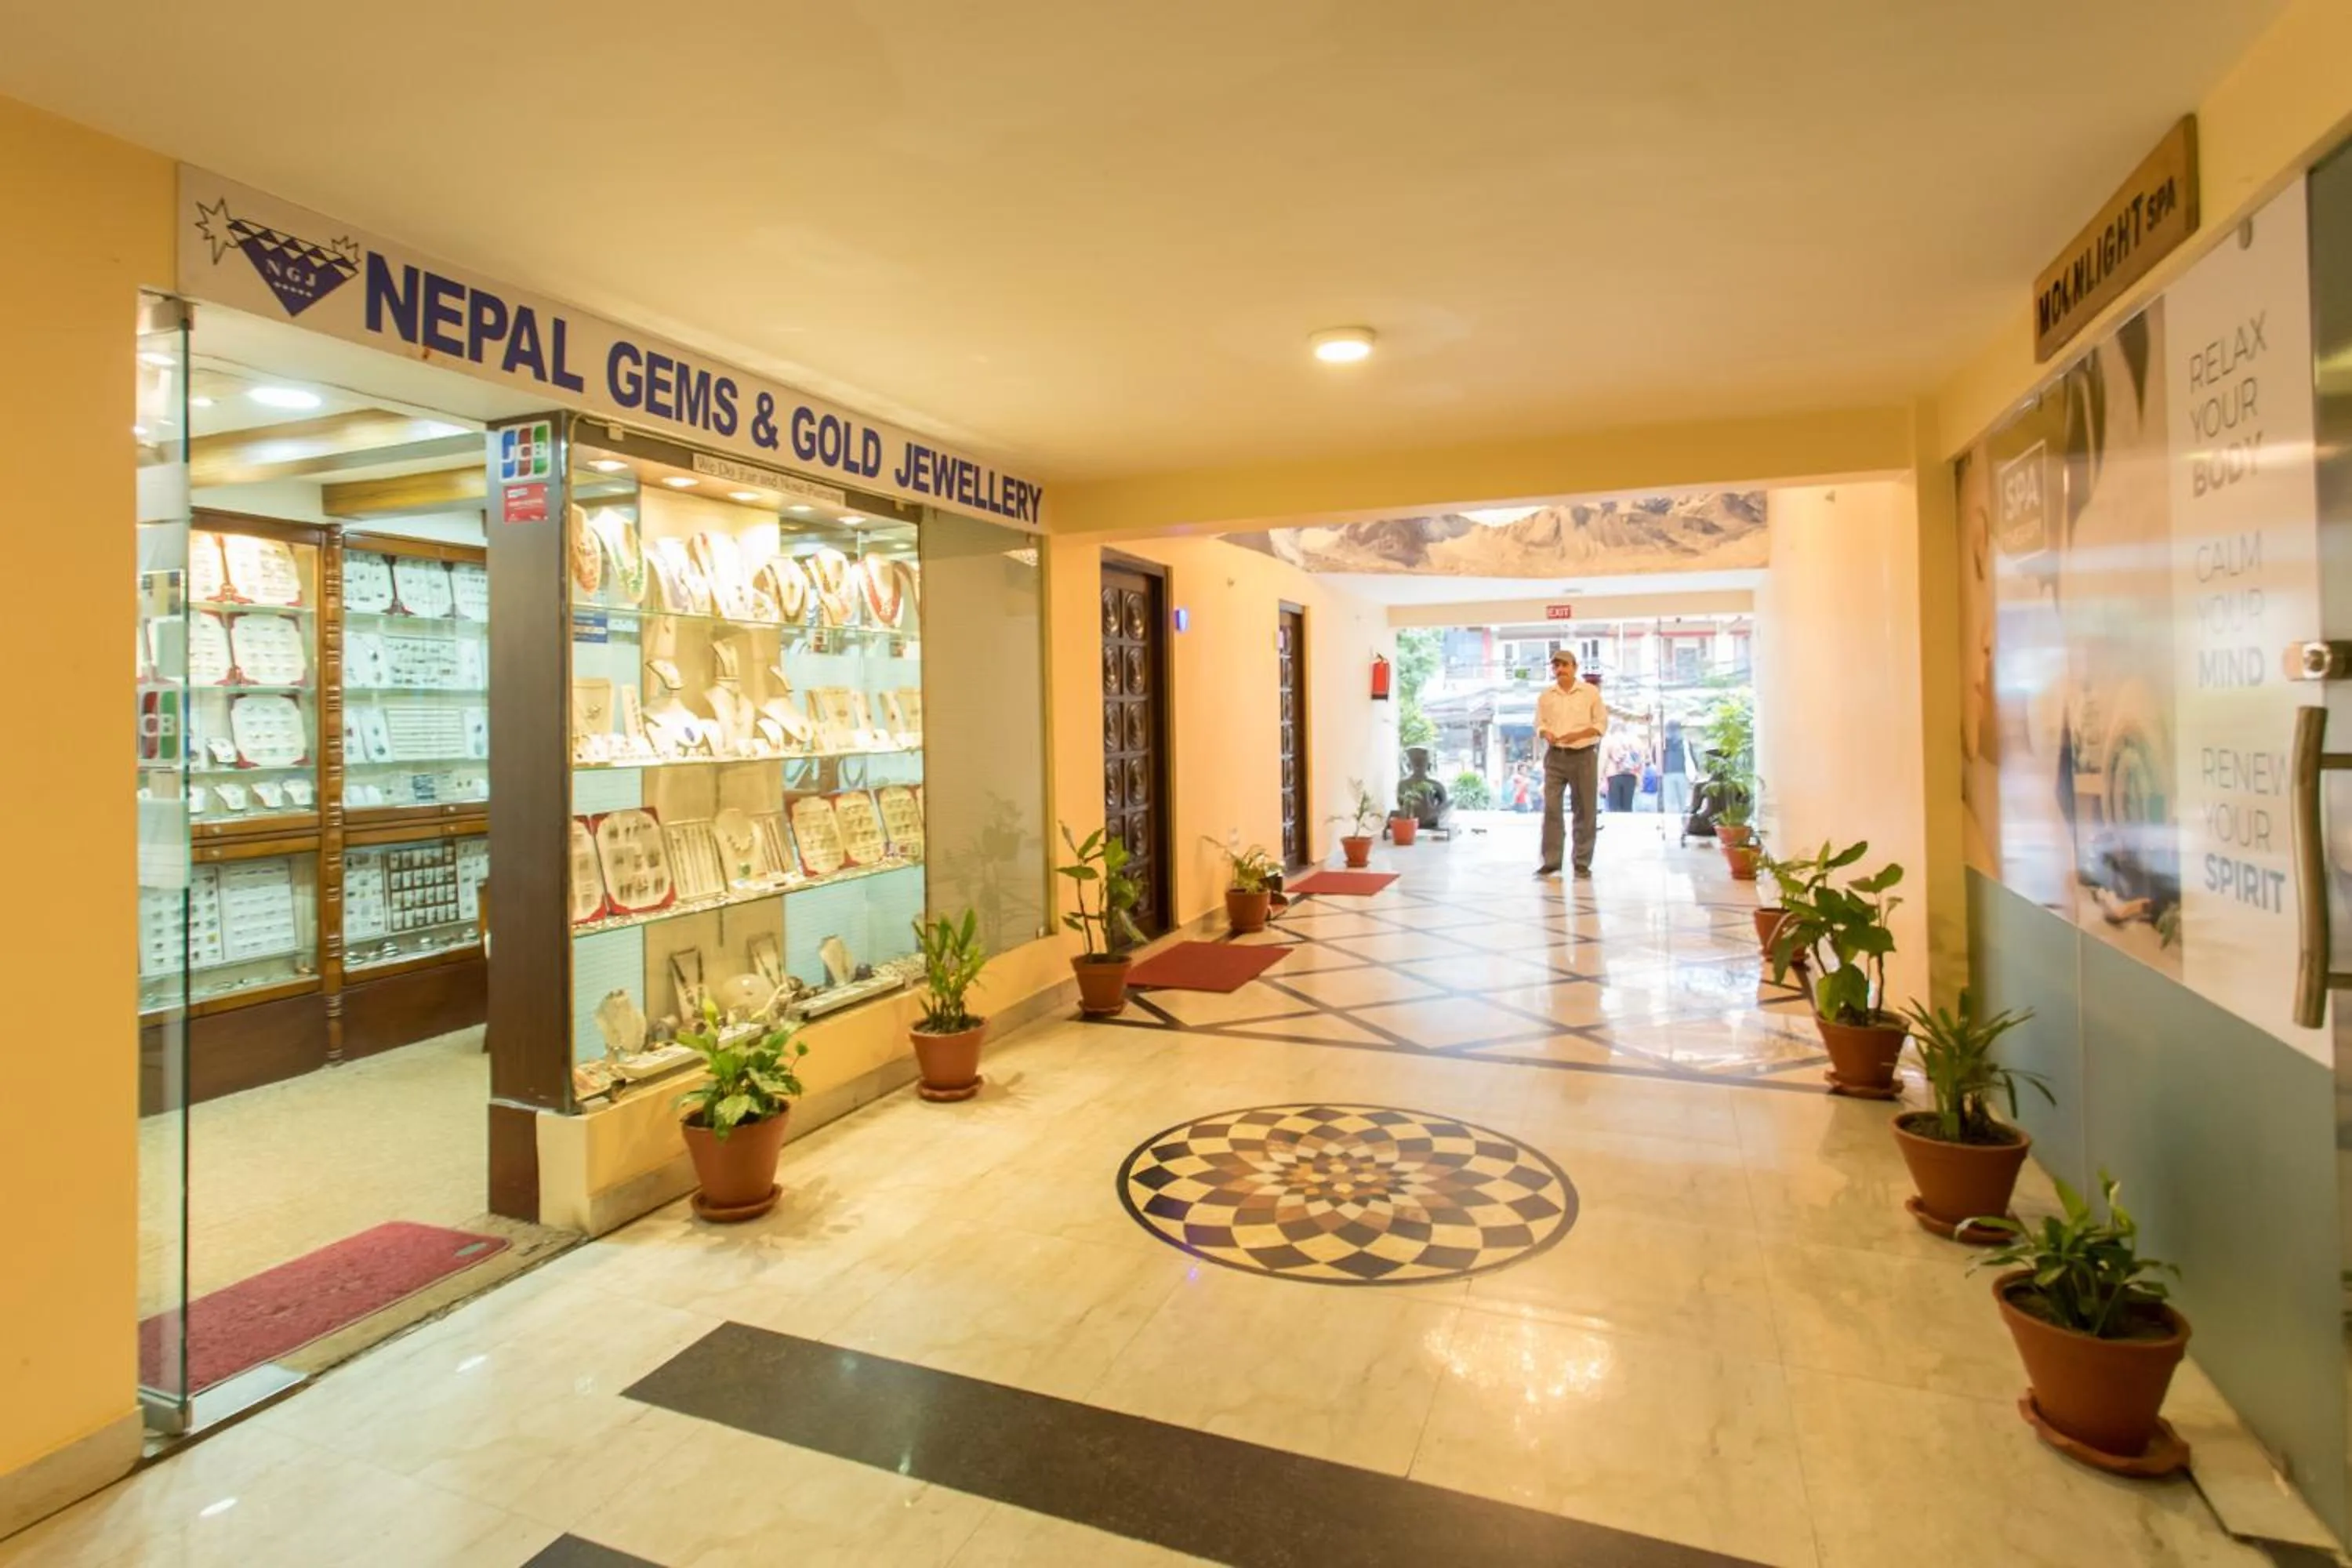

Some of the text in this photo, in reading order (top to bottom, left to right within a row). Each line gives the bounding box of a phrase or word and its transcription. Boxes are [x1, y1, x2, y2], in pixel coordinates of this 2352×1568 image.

[2147, 175, 2177, 232] SPA
[265, 257, 317, 288] NGJ
[2189, 309, 2267, 395] RELAX
[365, 249, 1044, 524] NEPAL GEMS & GOLD JEWELLERY
[2189, 376, 2259, 445] YOUR
[2004, 461, 2041, 521] SPA
[2192, 430, 2263, 498] BODY
[2195, 528, 2262, 584] CALM
[2198, 645, 2266, 688] MIND
[2202, 800, 2272, 853] YOUR
[2205, 852, 2286, 914] SPIRIT
